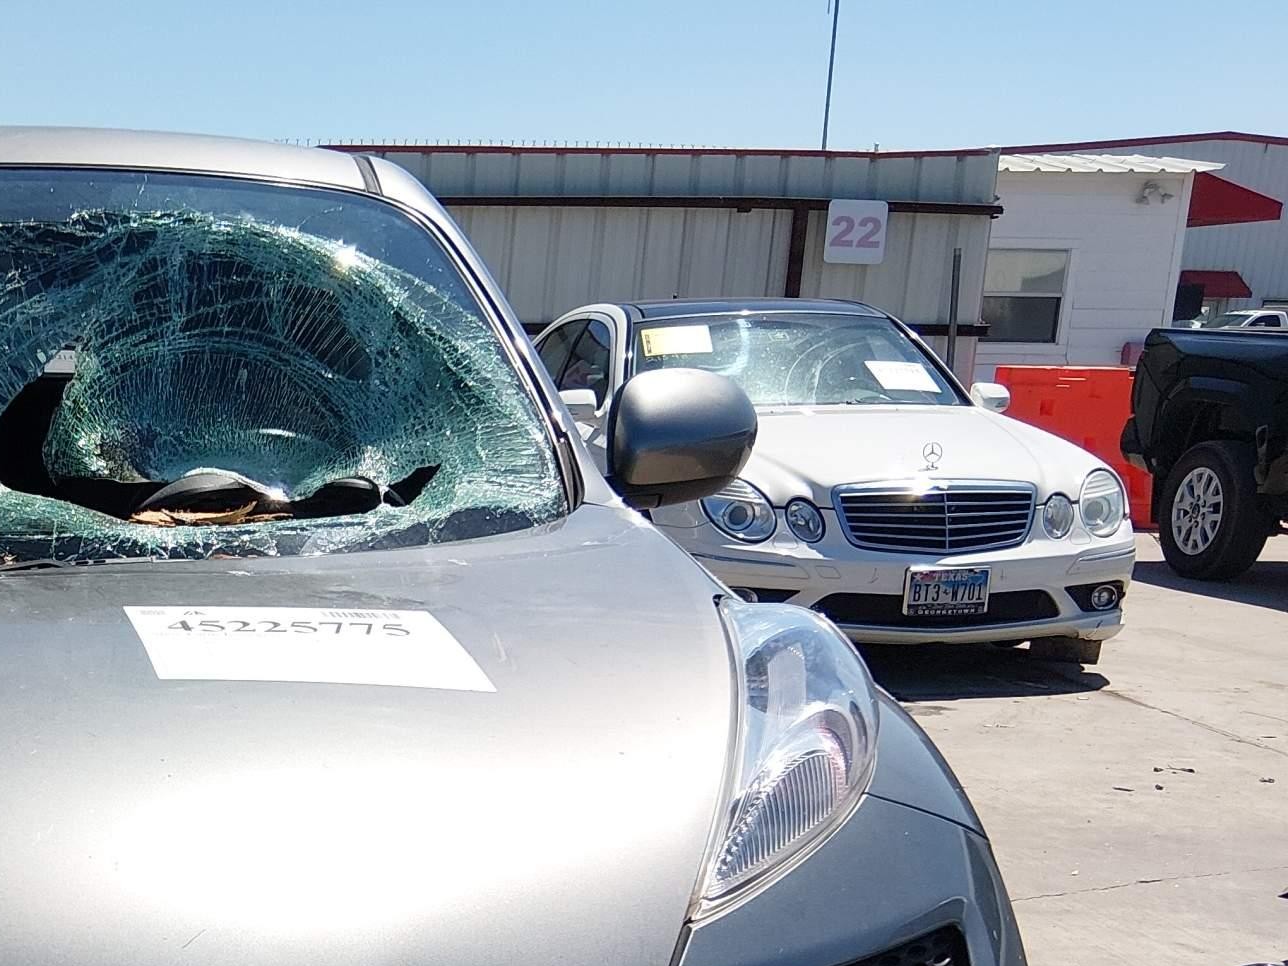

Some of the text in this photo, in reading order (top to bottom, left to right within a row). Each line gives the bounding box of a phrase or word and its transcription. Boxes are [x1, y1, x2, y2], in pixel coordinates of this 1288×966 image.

[829, 215, 882, 249] 22
[933, 571, 969, 582] TEXAS
[167, 619, 411, 637] 45225775
